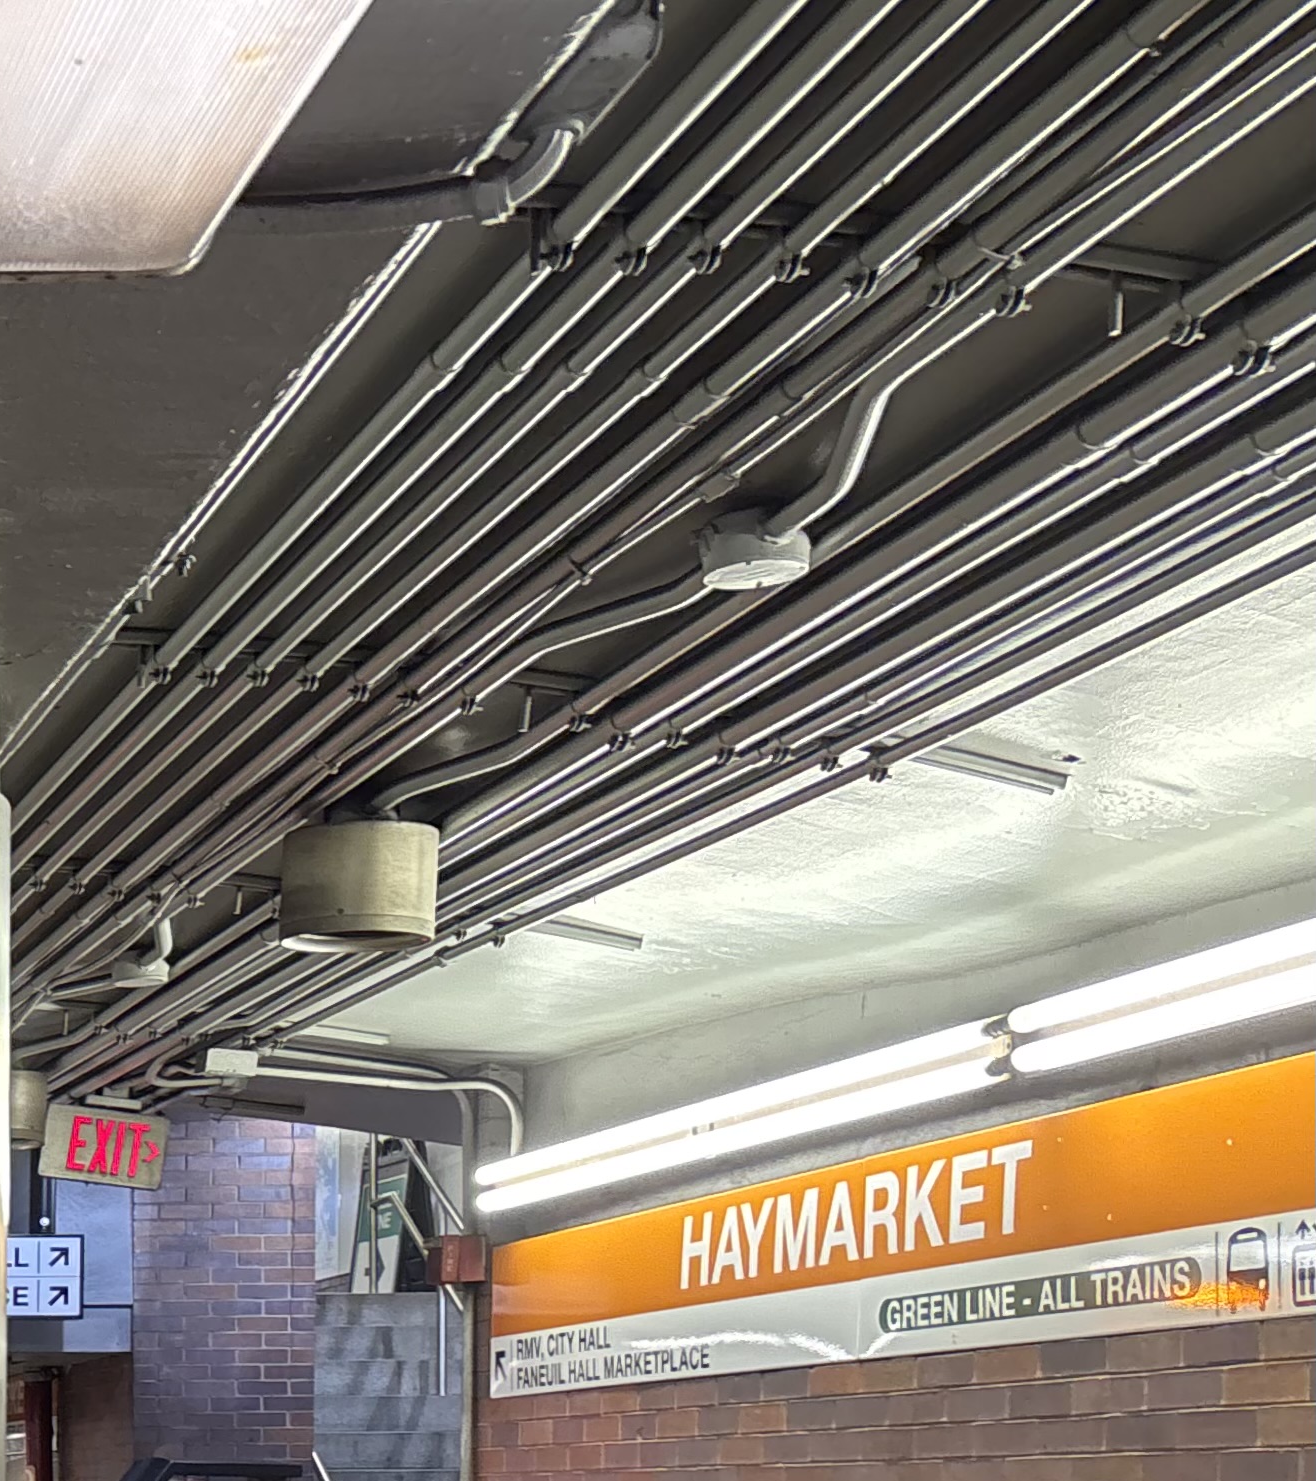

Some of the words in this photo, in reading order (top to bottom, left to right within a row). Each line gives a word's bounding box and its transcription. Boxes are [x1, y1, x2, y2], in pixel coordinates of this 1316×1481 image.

[66, 1115, 151, 1178] EXIT
[680, 1139, 1033, 1290] HAYMARKET
[886, 1292, 958, 1331] GREEN
[965, 1284, 1015, 1321] LINE
[1038, 1277, 1085, 1313] ALL
[1090, 1259, 1192, 1308] TRAINS
[516, 1363, 566, 1389] FANEUIL
[568, 1357, 600, 1384] HALL
[603, 1343, 710, 1379] MARKETPLACE
[517, 1338, 544, 1361] RMV,
[547, 1330, 575, 1357] CITY
[578, 1325, 611, 1351] HALL
